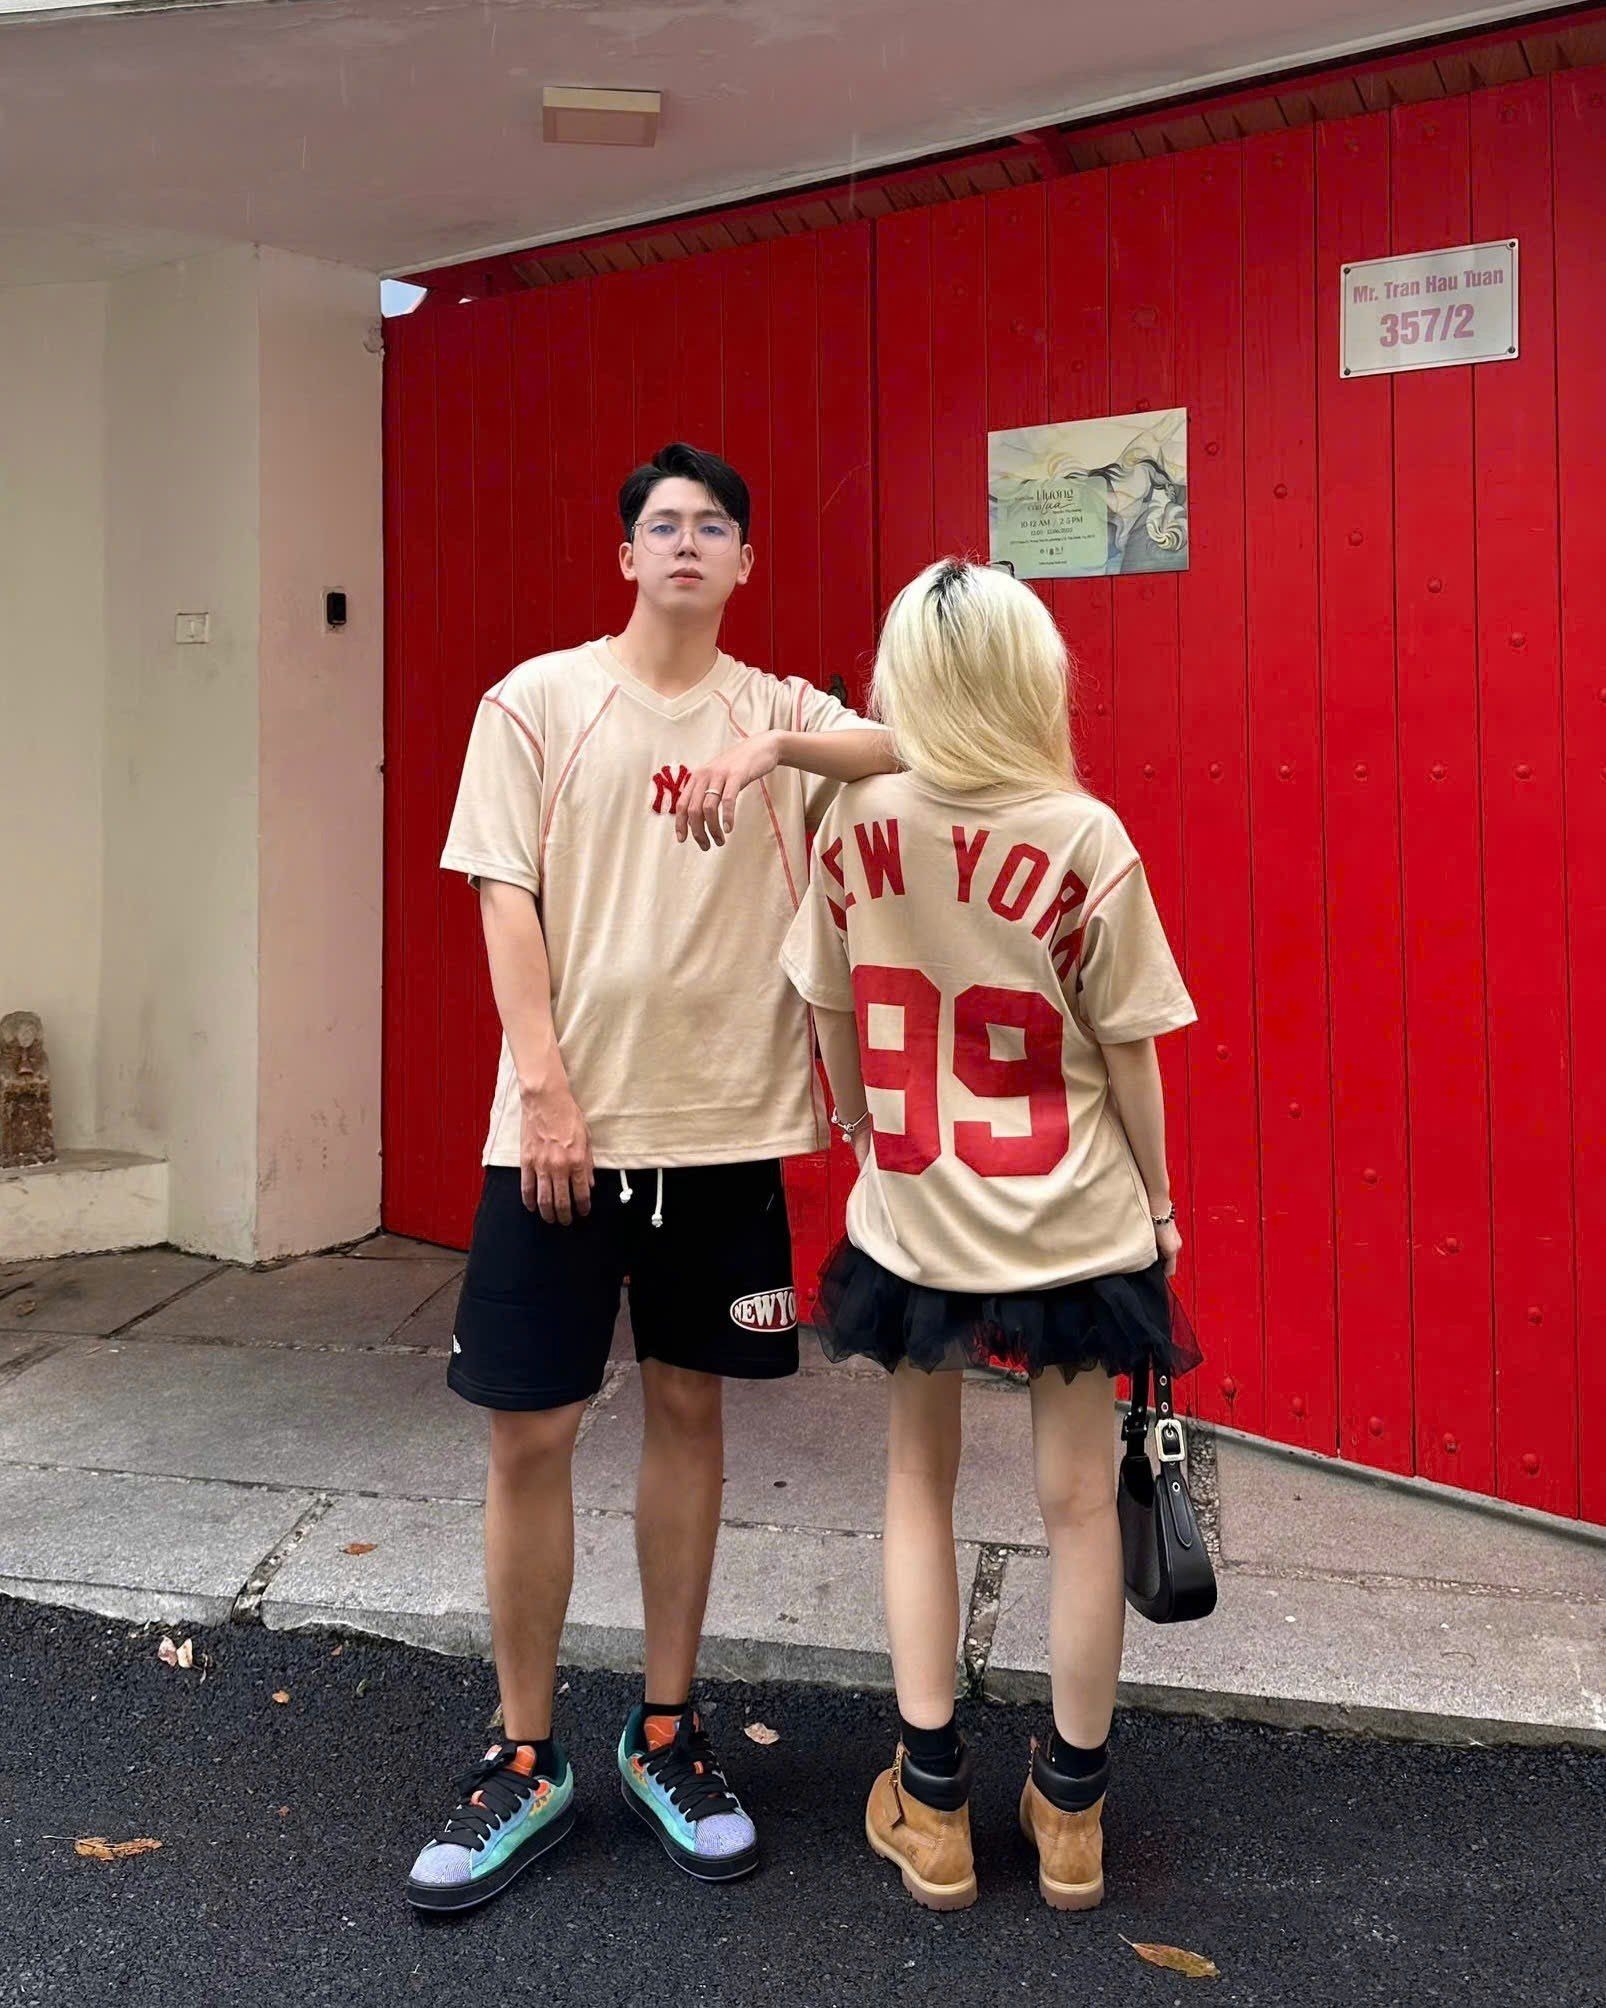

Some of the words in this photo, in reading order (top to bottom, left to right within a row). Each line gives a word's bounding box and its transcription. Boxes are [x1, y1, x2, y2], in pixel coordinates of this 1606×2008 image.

[1353, 285, 1378, 304] Mr.
[1384, 280, 1420, 299] Tran
[1425, 275, 1458, 294] Hau
[1463, 269, 1504, 288] Tuan
[1380, 304, 1475, 347] 357/2
[652, 764, 692, 815] NY
[852, 964, 1070, 1178] 99
